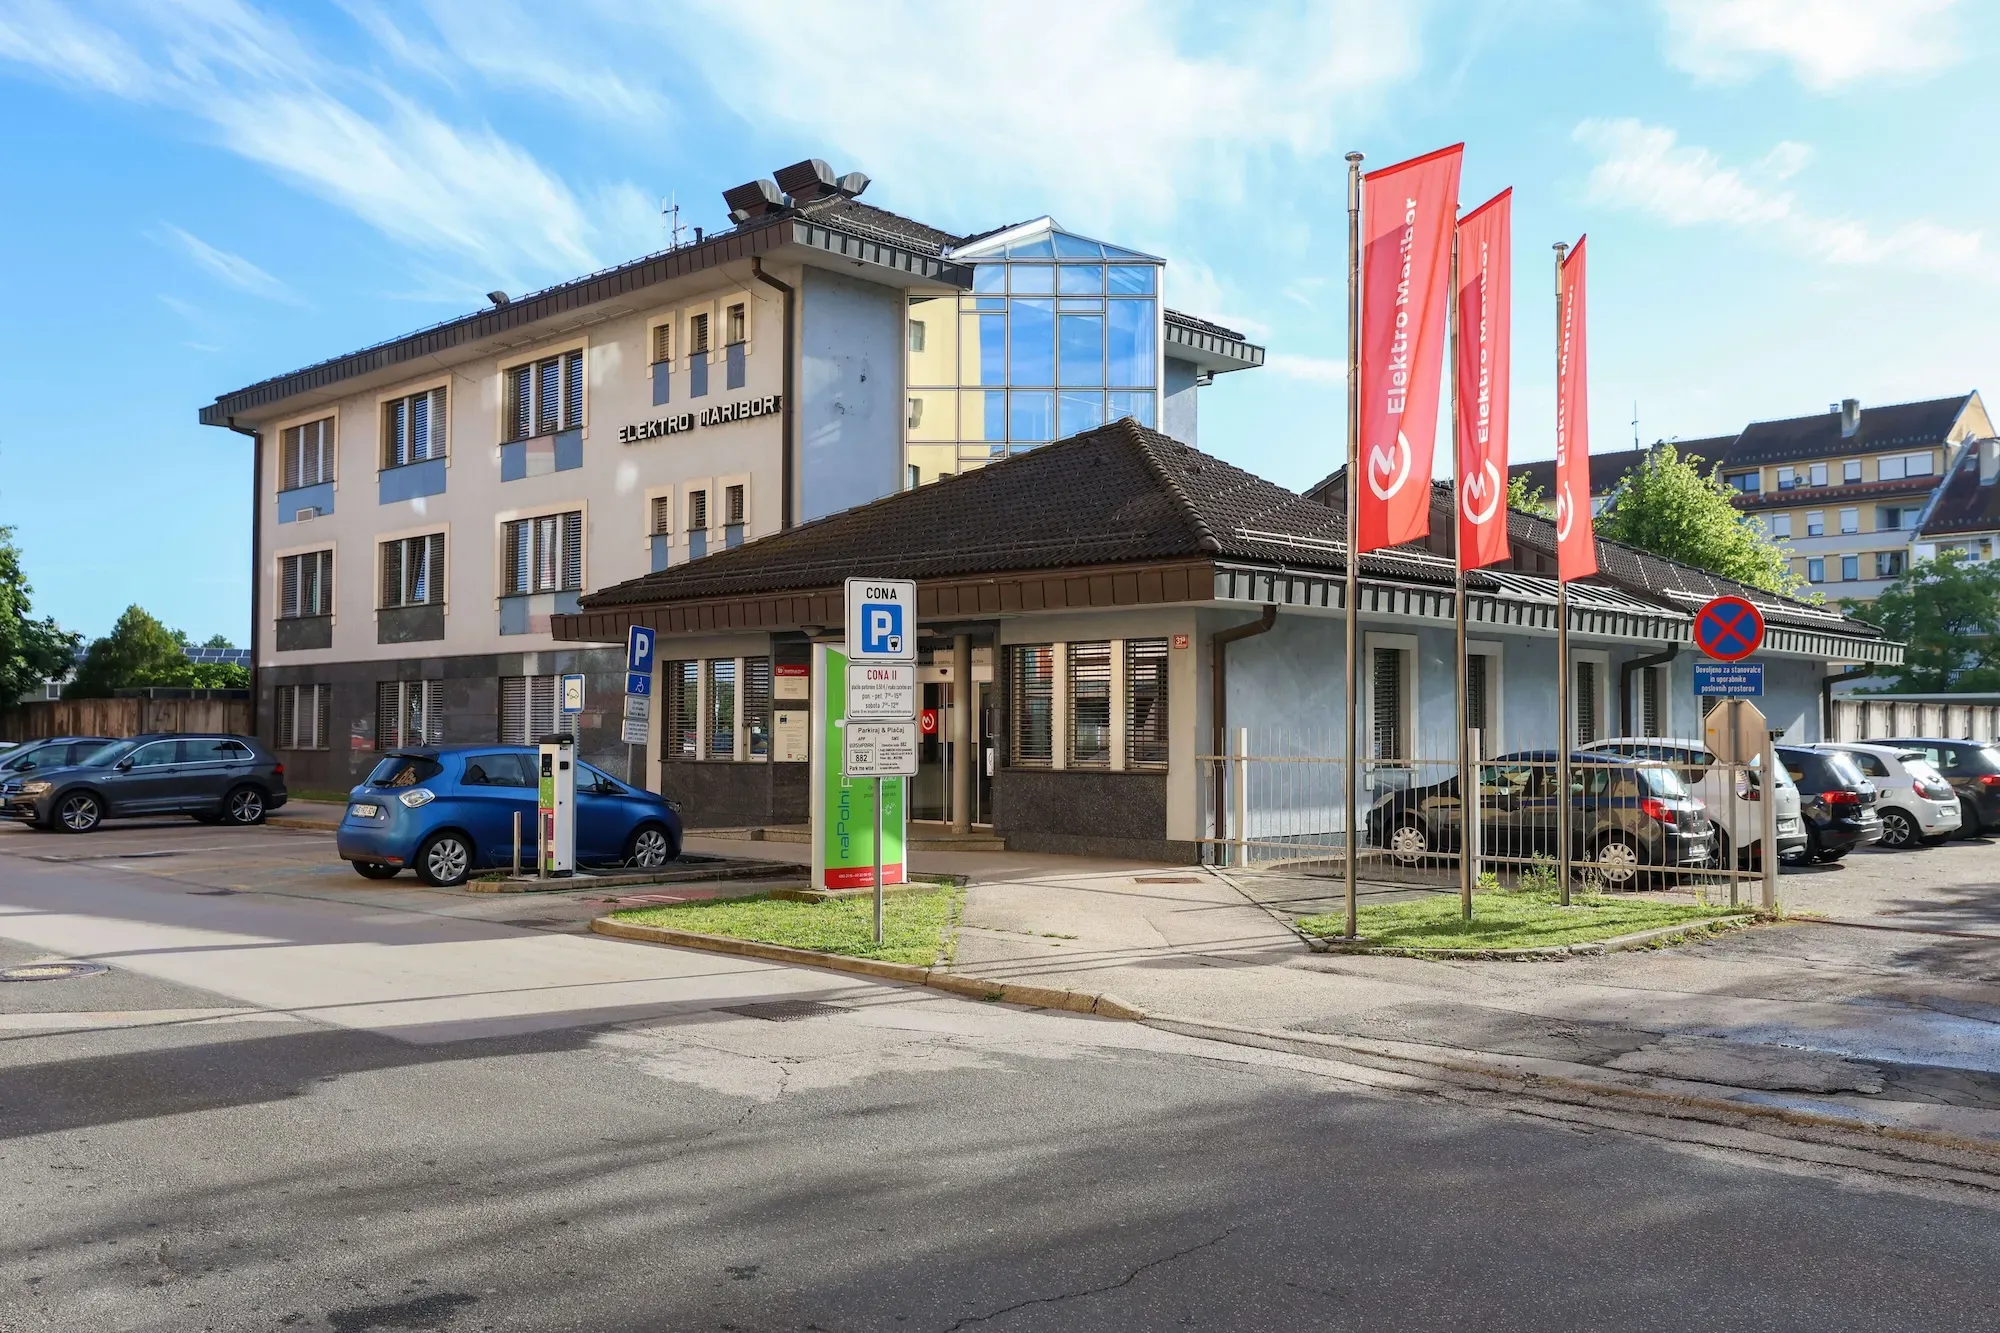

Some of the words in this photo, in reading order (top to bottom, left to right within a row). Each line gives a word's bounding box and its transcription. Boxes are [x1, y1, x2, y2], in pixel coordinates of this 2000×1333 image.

[1395, 197, 1417, 307] Maribor
[1387, 309, 1408, 414] Elektro
[1477, 348, 1489, 444] Elektro
[617, 413, 690, 443] ELEKTRO
[699, 395, 776, 426] MARIBOR
[866, 587, 897, 600] CONA
[871, 610, 892, 646] P
[635, 632, 649, 666] P
[867, 669, 889, 680] CONA
[892, 670, 897, 680] II
[1696, 666, 1722, 675] Dovoljeno
[1731, 666, 1761, 674] stanovalce
[1716, 675, 1746, 684] uporabnike
[1701, 685, 1727, 693] poslovnih
[1728, 685, 1755, 693] prostorov
[887, 726, 905, 734] Plačaj
[855, 754, 868, 762] 882
